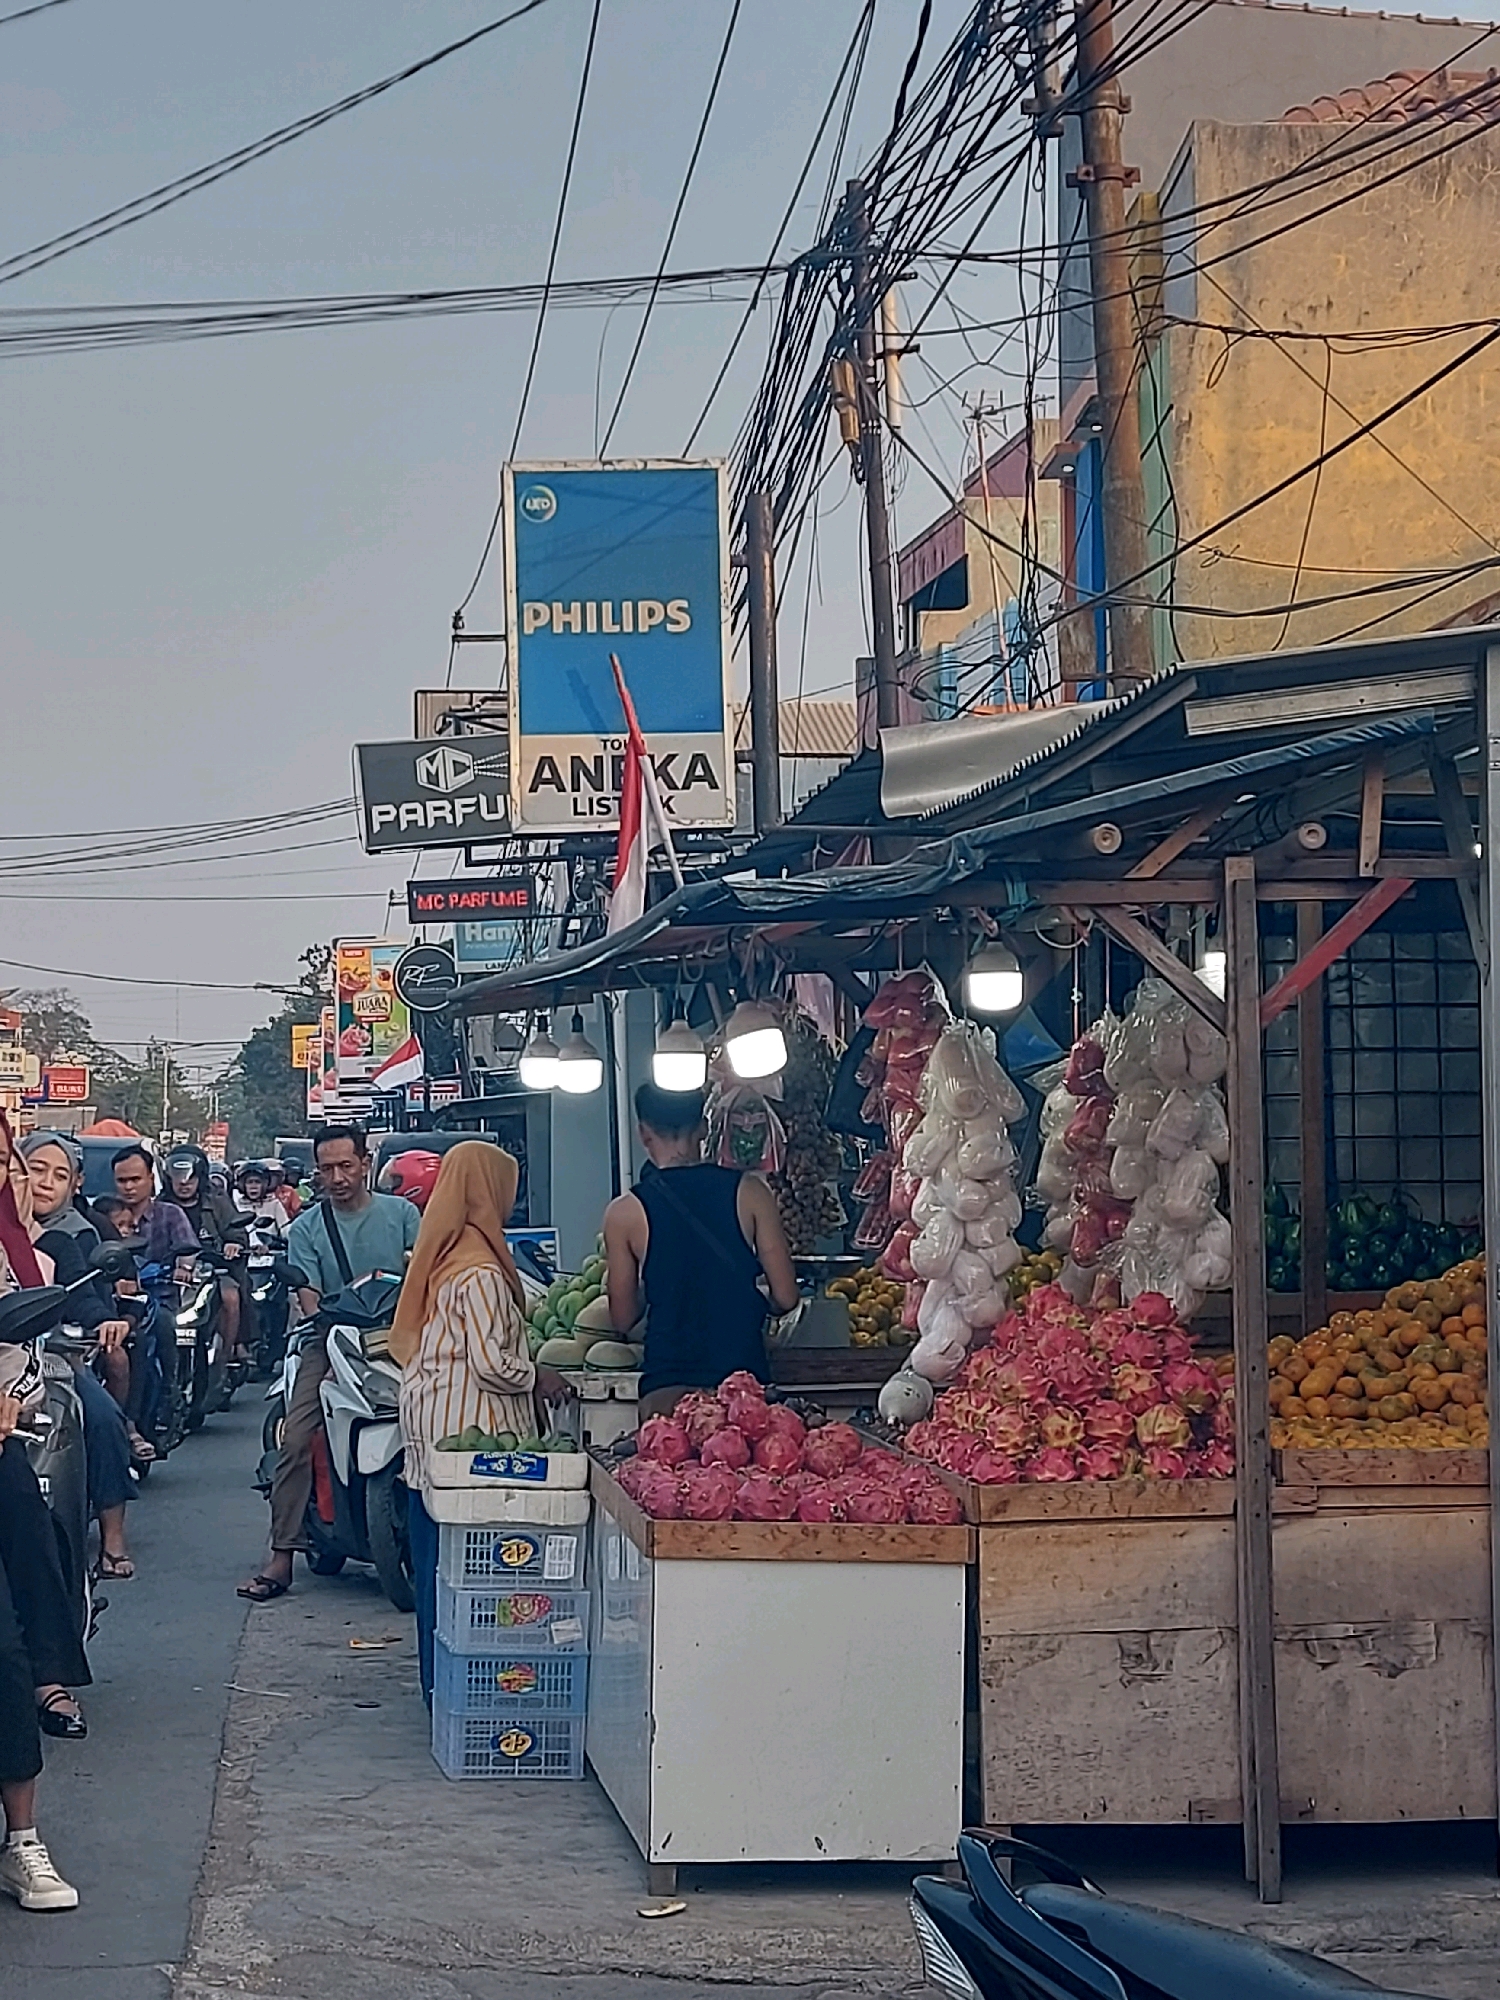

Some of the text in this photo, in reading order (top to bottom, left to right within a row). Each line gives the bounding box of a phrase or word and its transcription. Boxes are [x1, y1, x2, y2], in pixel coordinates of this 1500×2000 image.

[523, 599, 692, 634] PHILIPS
[416, 746, 475, 793] MC
[371, 792, 511, 834] PARFU
[572, 795, 677, 817] LISTK
[416, 889, 529, 911] MC PARFUME
[356, 996, 388, 1012] JUARA
